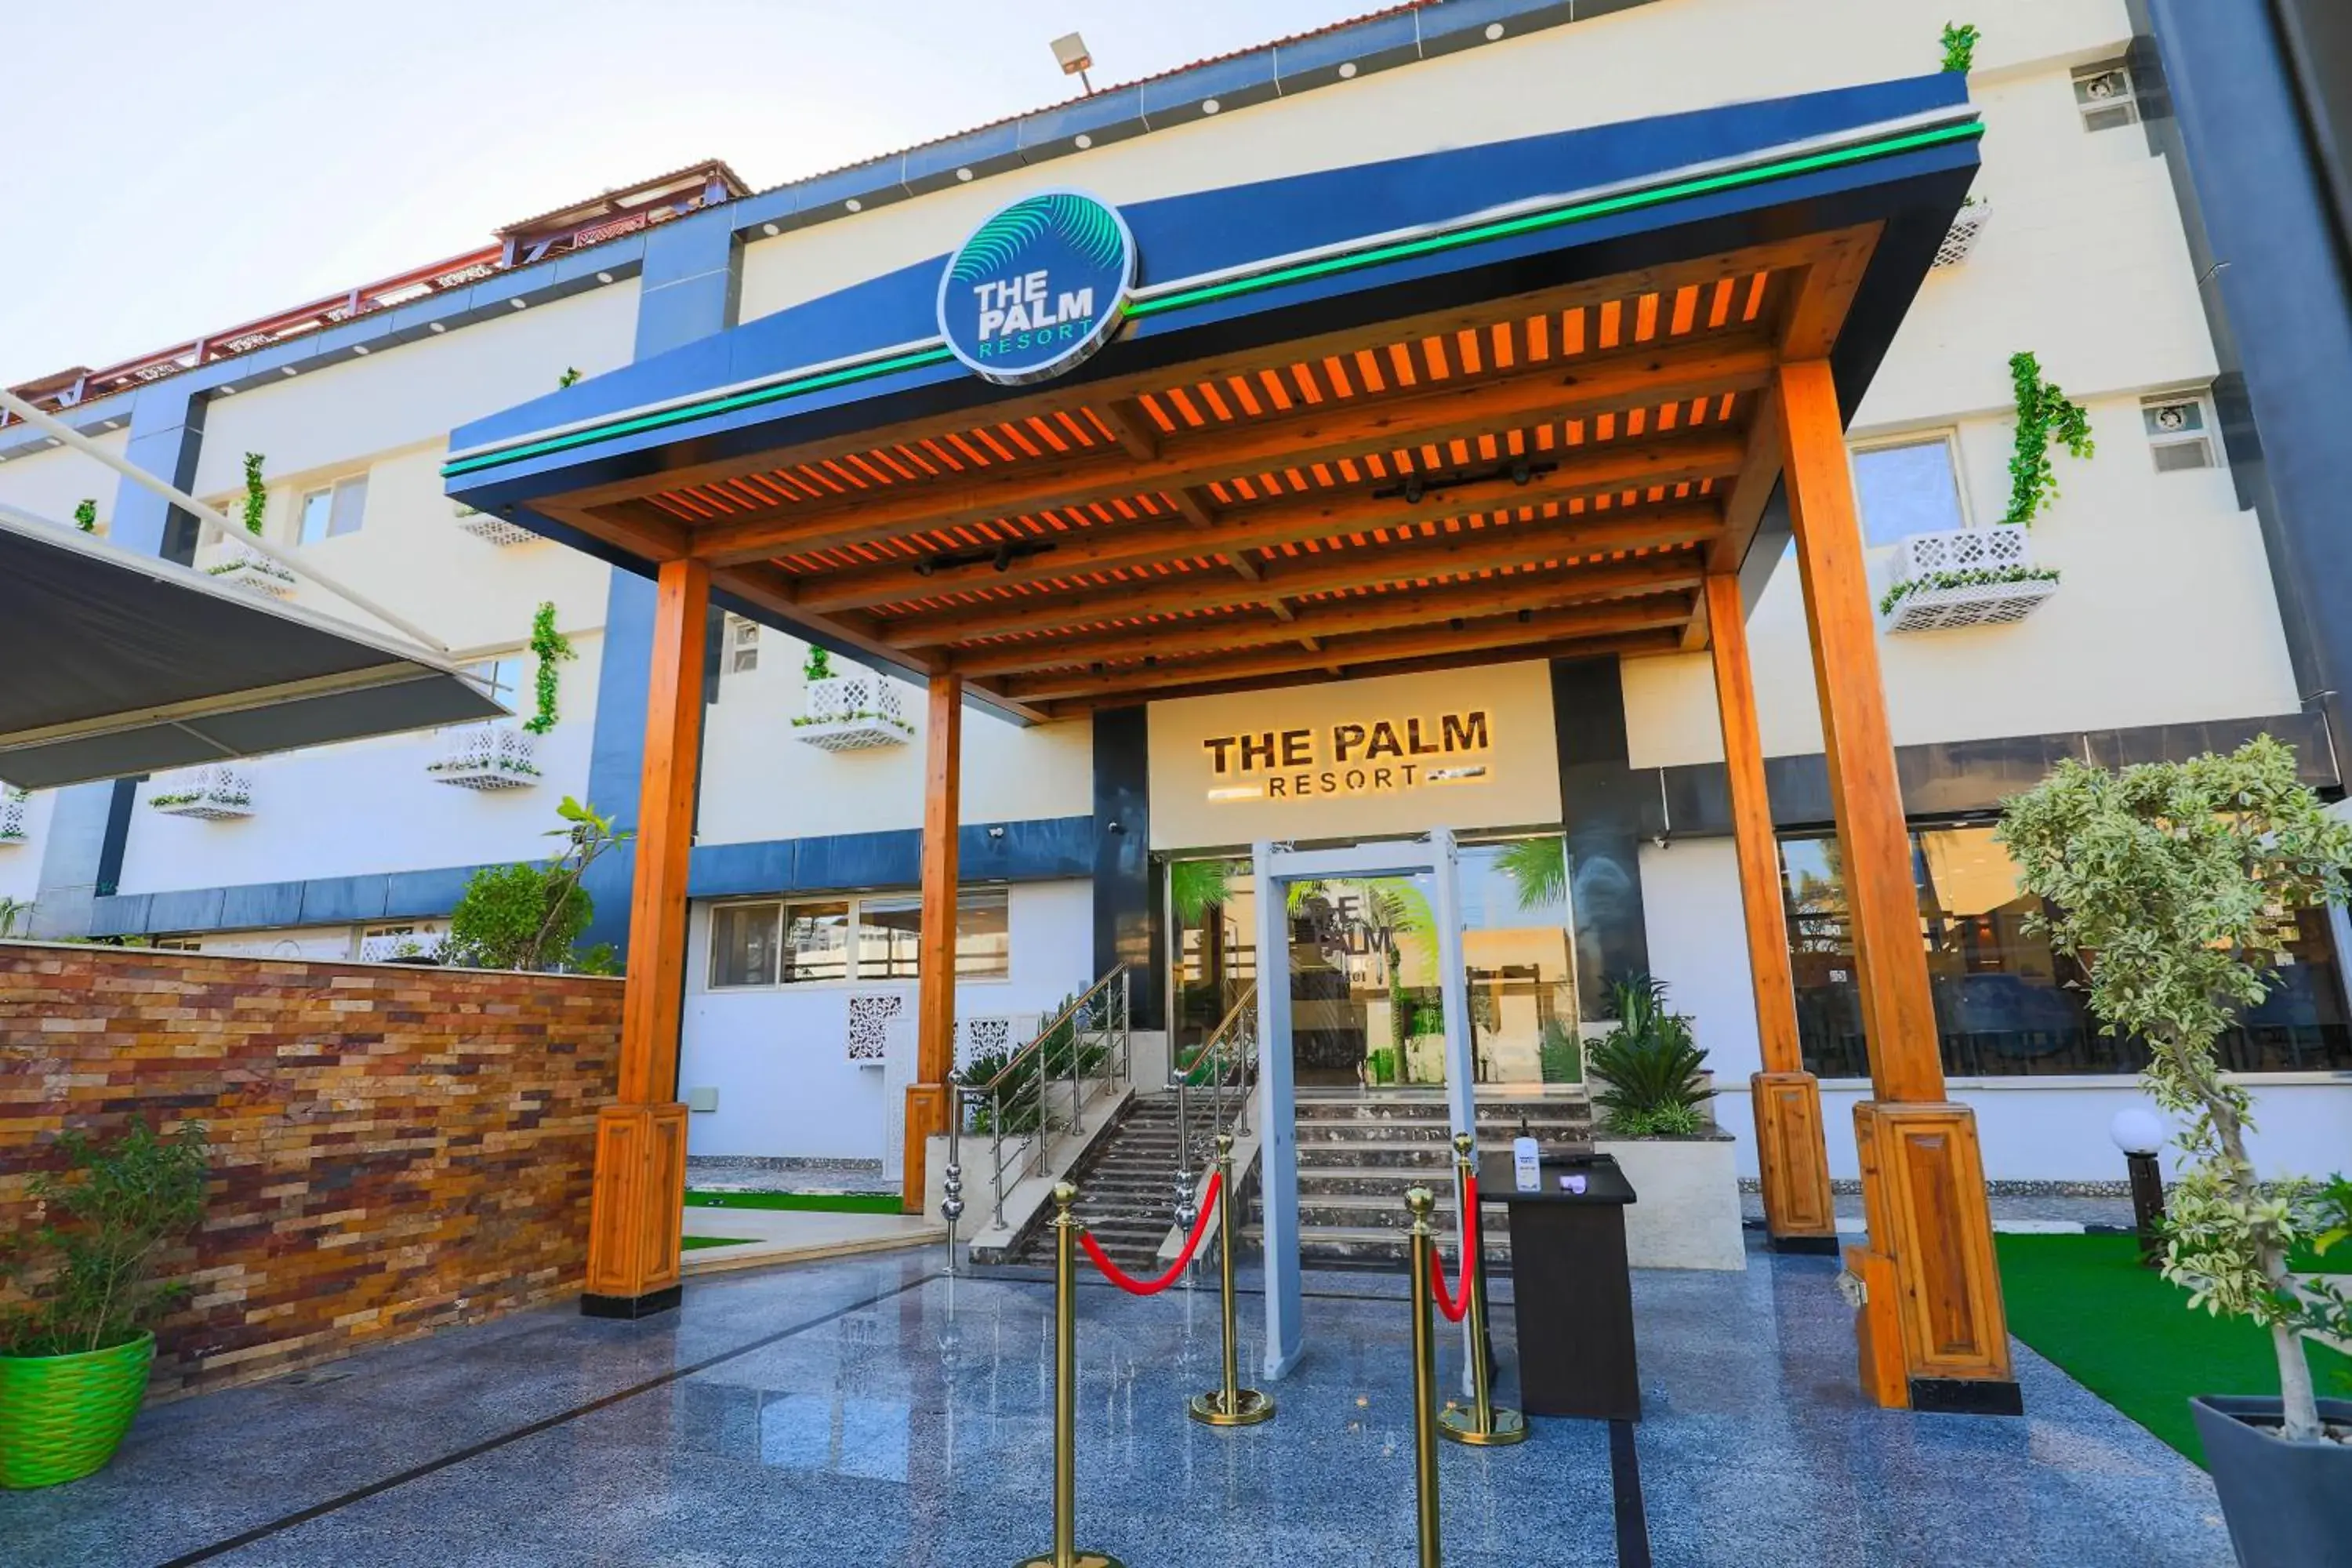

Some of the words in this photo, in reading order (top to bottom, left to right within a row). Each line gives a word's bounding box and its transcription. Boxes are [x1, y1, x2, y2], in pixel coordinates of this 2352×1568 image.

[973, 270, 1049, 313] THE
[978, 287, 1094, 341] PALM
[979, 319, 1093, 359] RESORT
[1203, 728, 1314, 773] THE
[1334, 711, 1489, 762] PALM
[1269, 764, 1417, 797] RESORT
